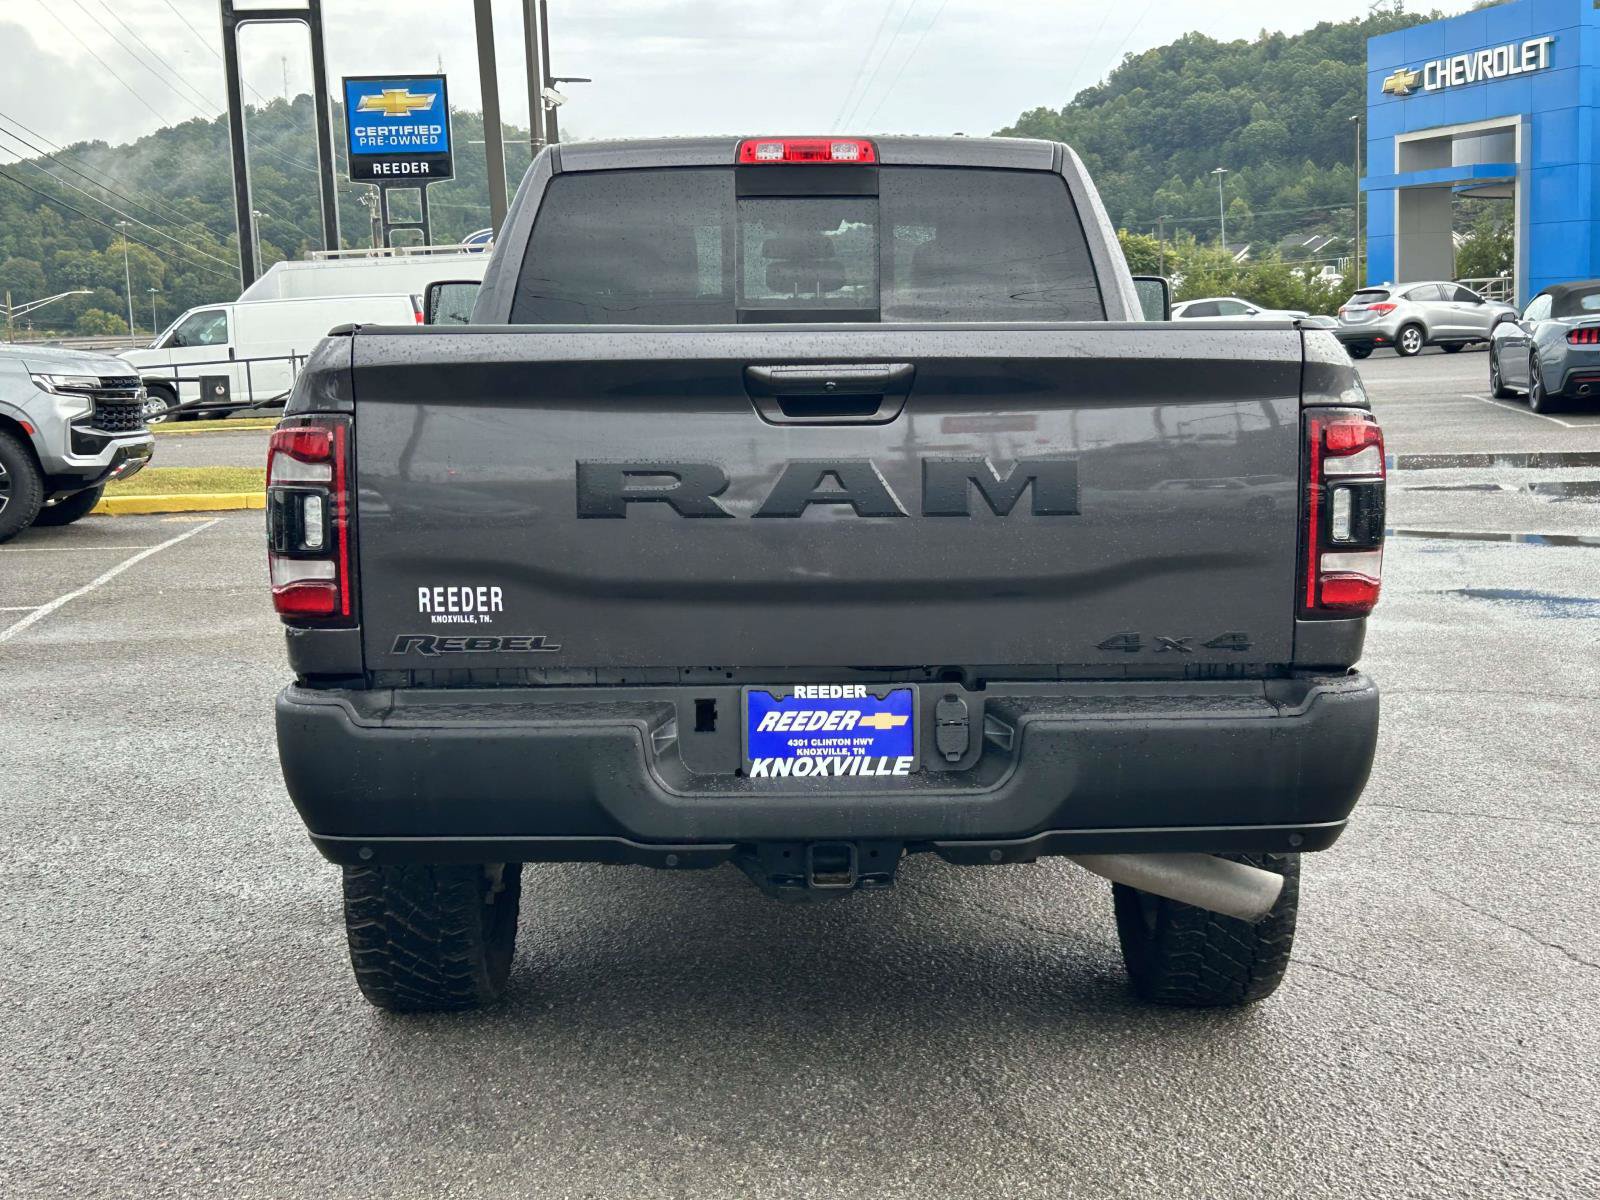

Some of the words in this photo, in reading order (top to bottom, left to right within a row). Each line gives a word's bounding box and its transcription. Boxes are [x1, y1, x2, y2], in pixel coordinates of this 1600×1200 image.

[1424, 36, 1555, 91] CHEVROLET
[355, 125, 442, 136] CERTIFIED
[360, 135, 438, 146] PRE-OWNED
[373, 162, 430, 174] REEDER
[576, 457, 1081, 519] RAM
[418, 586, 504, 613] REEDER
[431, 615, 478, 624] KNOXVILLE,
[479, 615, 493, 623] TN.
[390, 634, 562, 657] REBEL
[793, 684, 868, 699] REEDER
[756, 710, 862, 732] REEDER
[787, 738, 809, 747] 4301
[811, 738, 852, 746] CLINTON
[853, 738, 874, 746] HWY
[796, 748, 851, 756] KNOXVILLE,
[749, 756, 914, 778] KNOXVILLE
